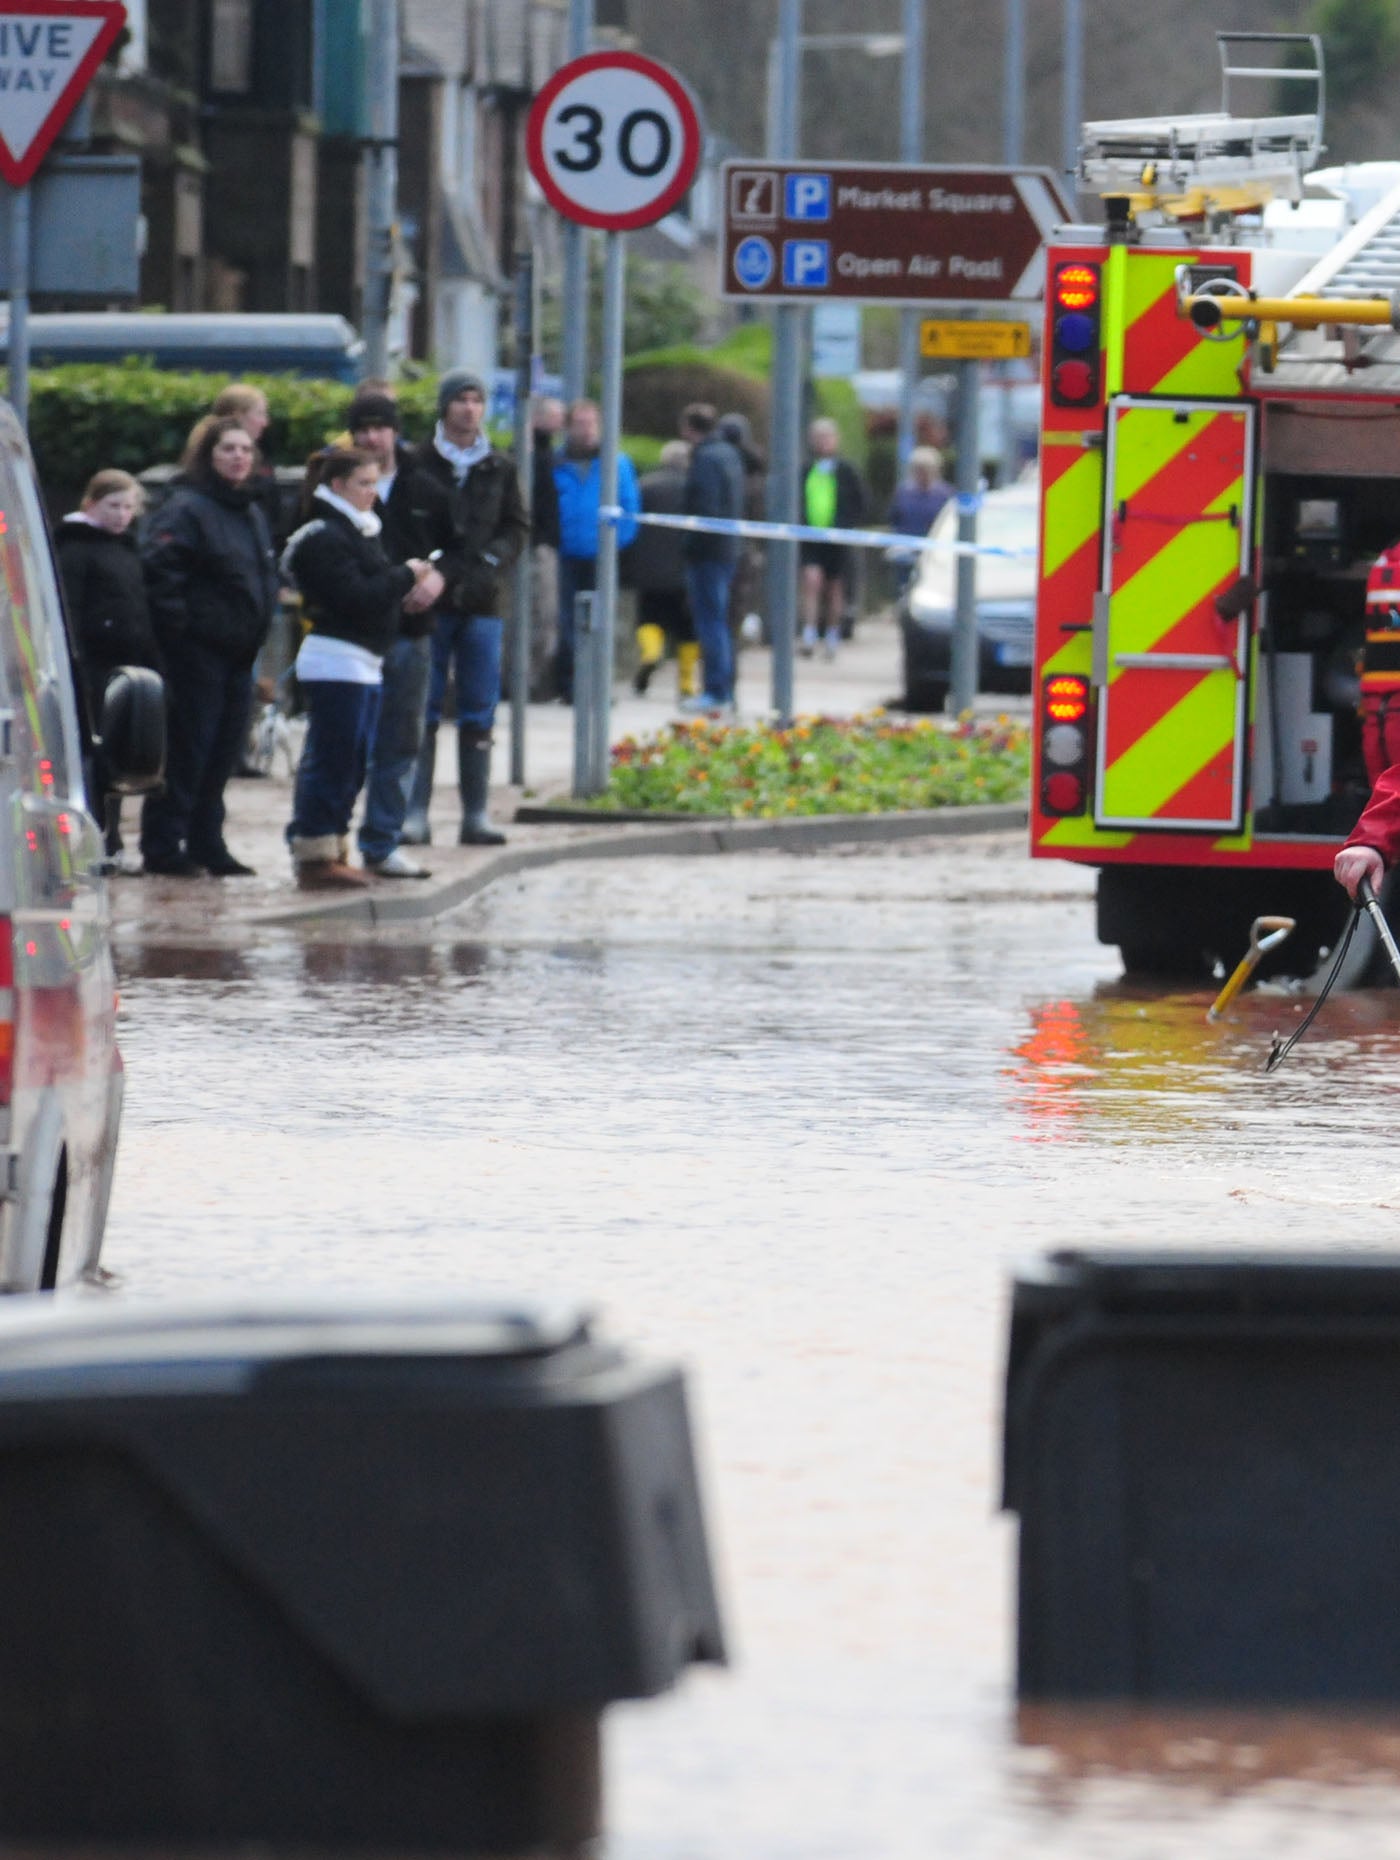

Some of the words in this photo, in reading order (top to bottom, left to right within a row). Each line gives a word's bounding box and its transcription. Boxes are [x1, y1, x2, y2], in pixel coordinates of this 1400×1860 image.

[554, 103, 672, 177] 30
[795, 178, 824, 217] P
[837, 186, 921, 211] Market
[929, 187, 1015, 214] Square
[794, 245, 822, 284] P
[837, 252, 899, 278] Open
[908, 254, 941, 276] Air
[949, 254, 1003, 279] Pool
